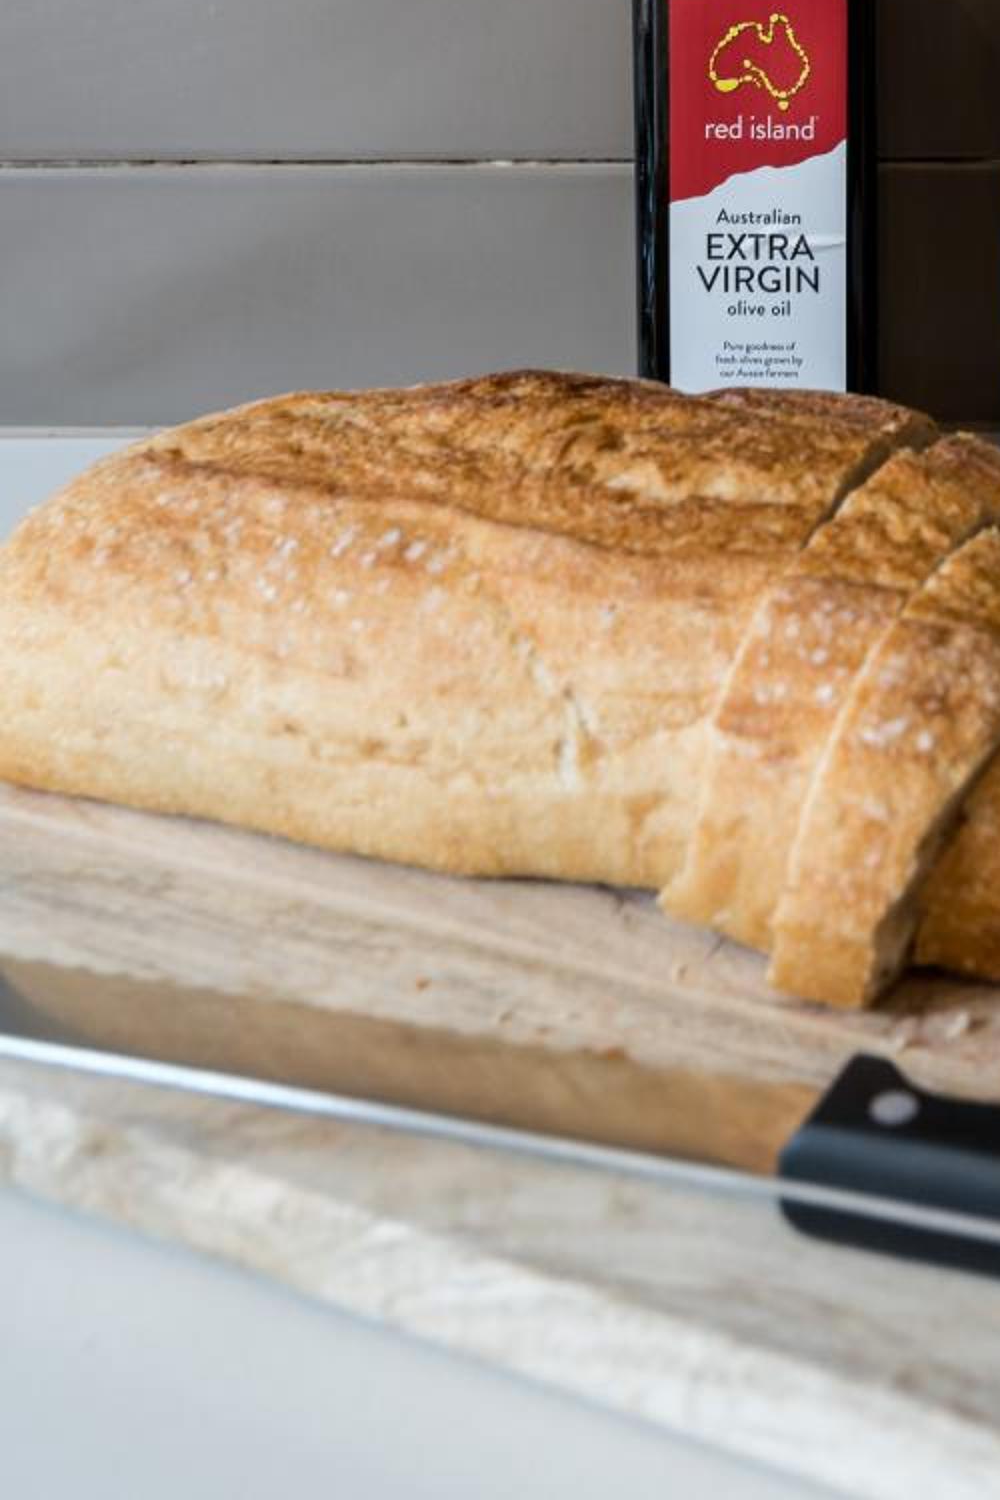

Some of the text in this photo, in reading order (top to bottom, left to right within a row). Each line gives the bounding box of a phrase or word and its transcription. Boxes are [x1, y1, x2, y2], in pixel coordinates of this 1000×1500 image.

[704, 115, 816, 140] red island
[716, 208, 802, 226] Australian
[706, 232, 815, 261] EXTRA
[696, 265, 820, 294] VIRGIN
[726, 300, 792, 317] olive oil
